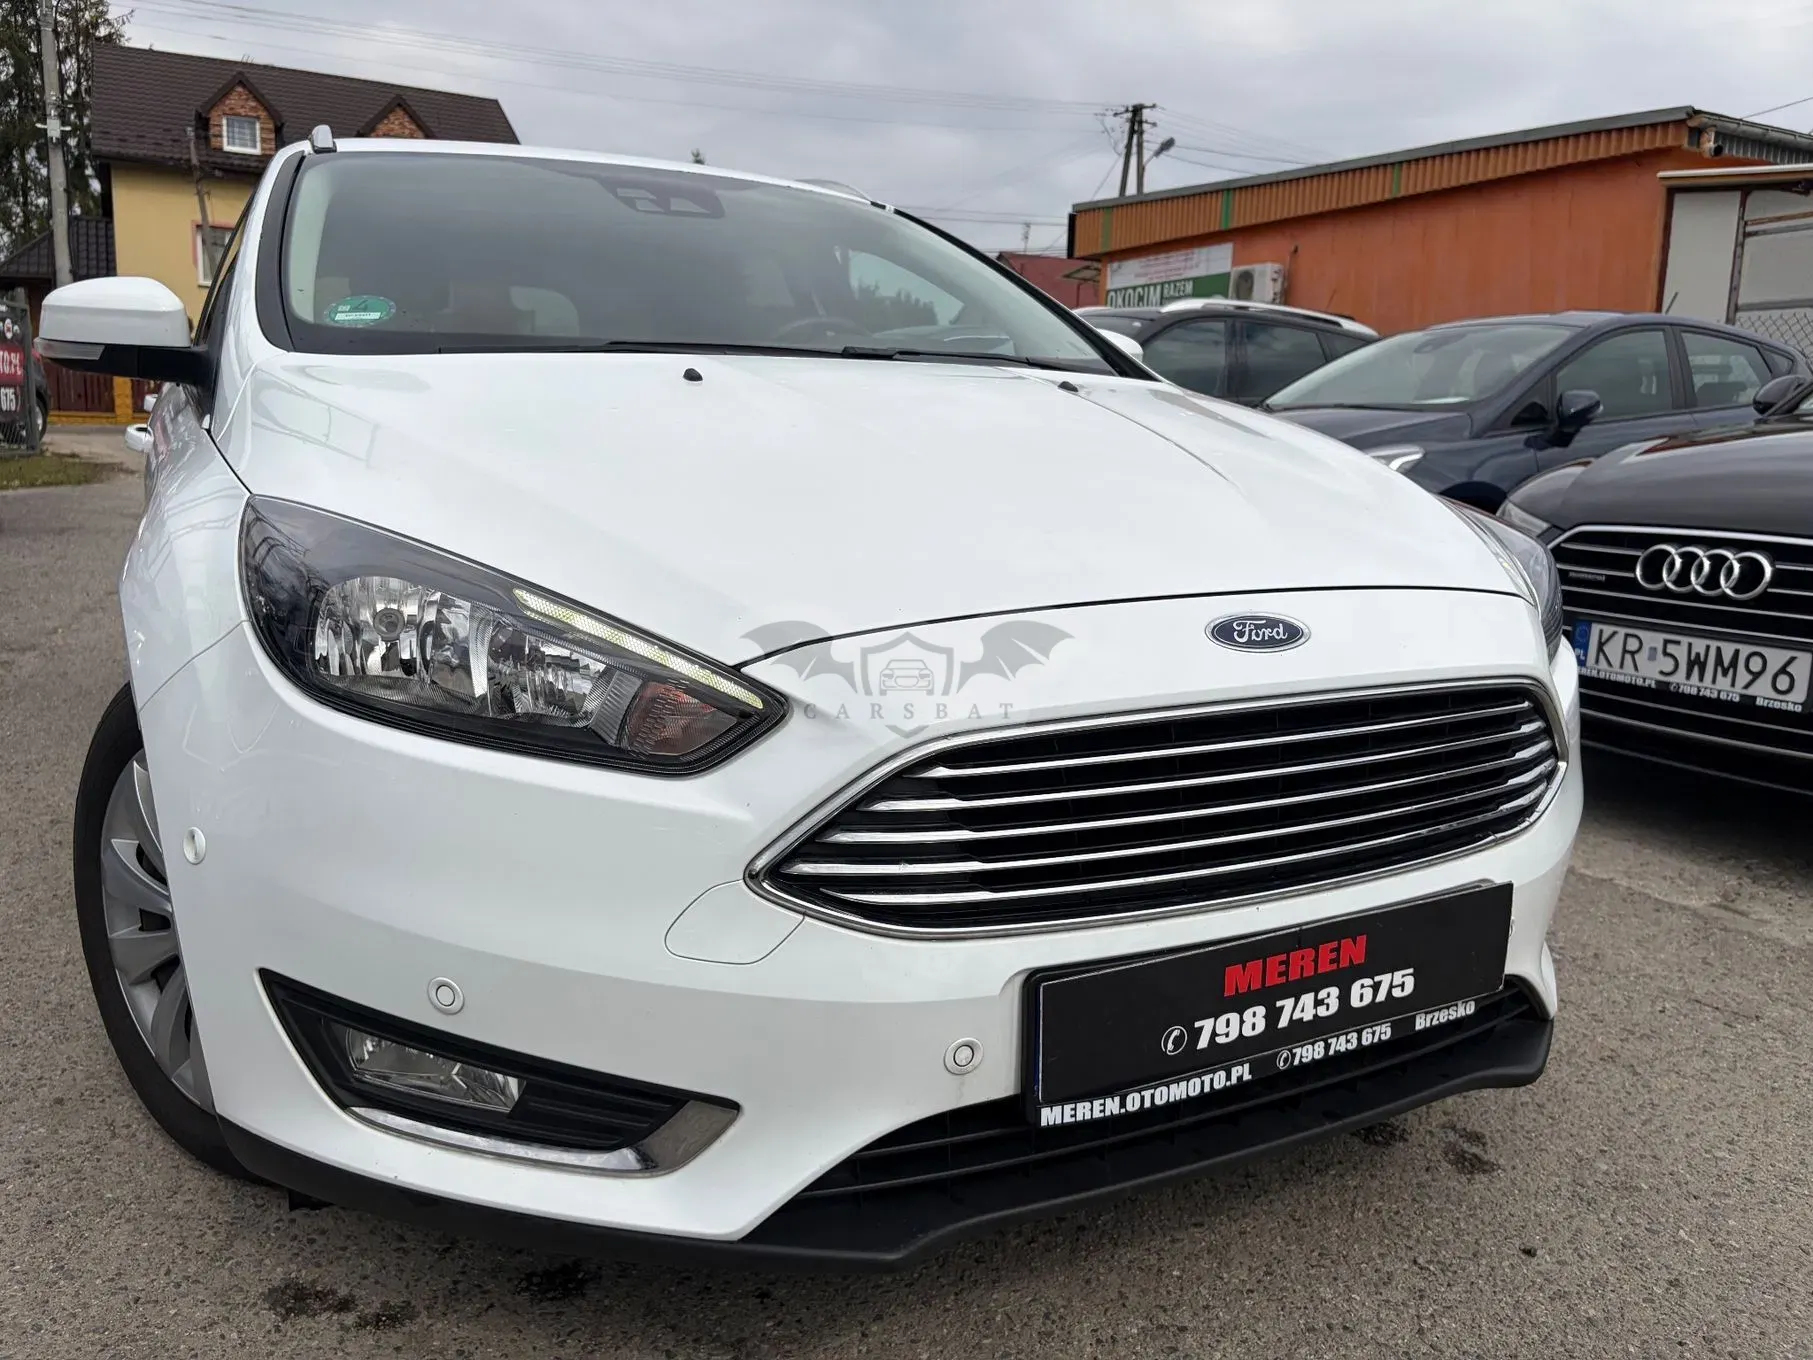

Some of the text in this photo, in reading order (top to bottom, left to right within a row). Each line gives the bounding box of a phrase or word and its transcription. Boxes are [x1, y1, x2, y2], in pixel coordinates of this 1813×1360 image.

[1107, 280, 1194, 308] OKOCIM RAZEM
[0, 387, 16, 412] 675
[1233, 619, 1288, 643] Ford
[1574, 648, 1586, 661] PL
[1594, 628, 1799, 696] KR 5WM96
[1755, 696, 1803, 713] Brzesko
[1223, 934, 1368, 997] MEREN
[1194, 967, 1415, 1051] 798 743 675
[1040, 1062, 1253, 1127] MEREN.OTOMOTO.PL
[1292, 1043, 1325, 1067] 798
[1328, 1035, 1358, 1057] 743
[1361, 1023, 1392, 1046] 675
[1415, 1000, 1476, 1032] Brzesko
